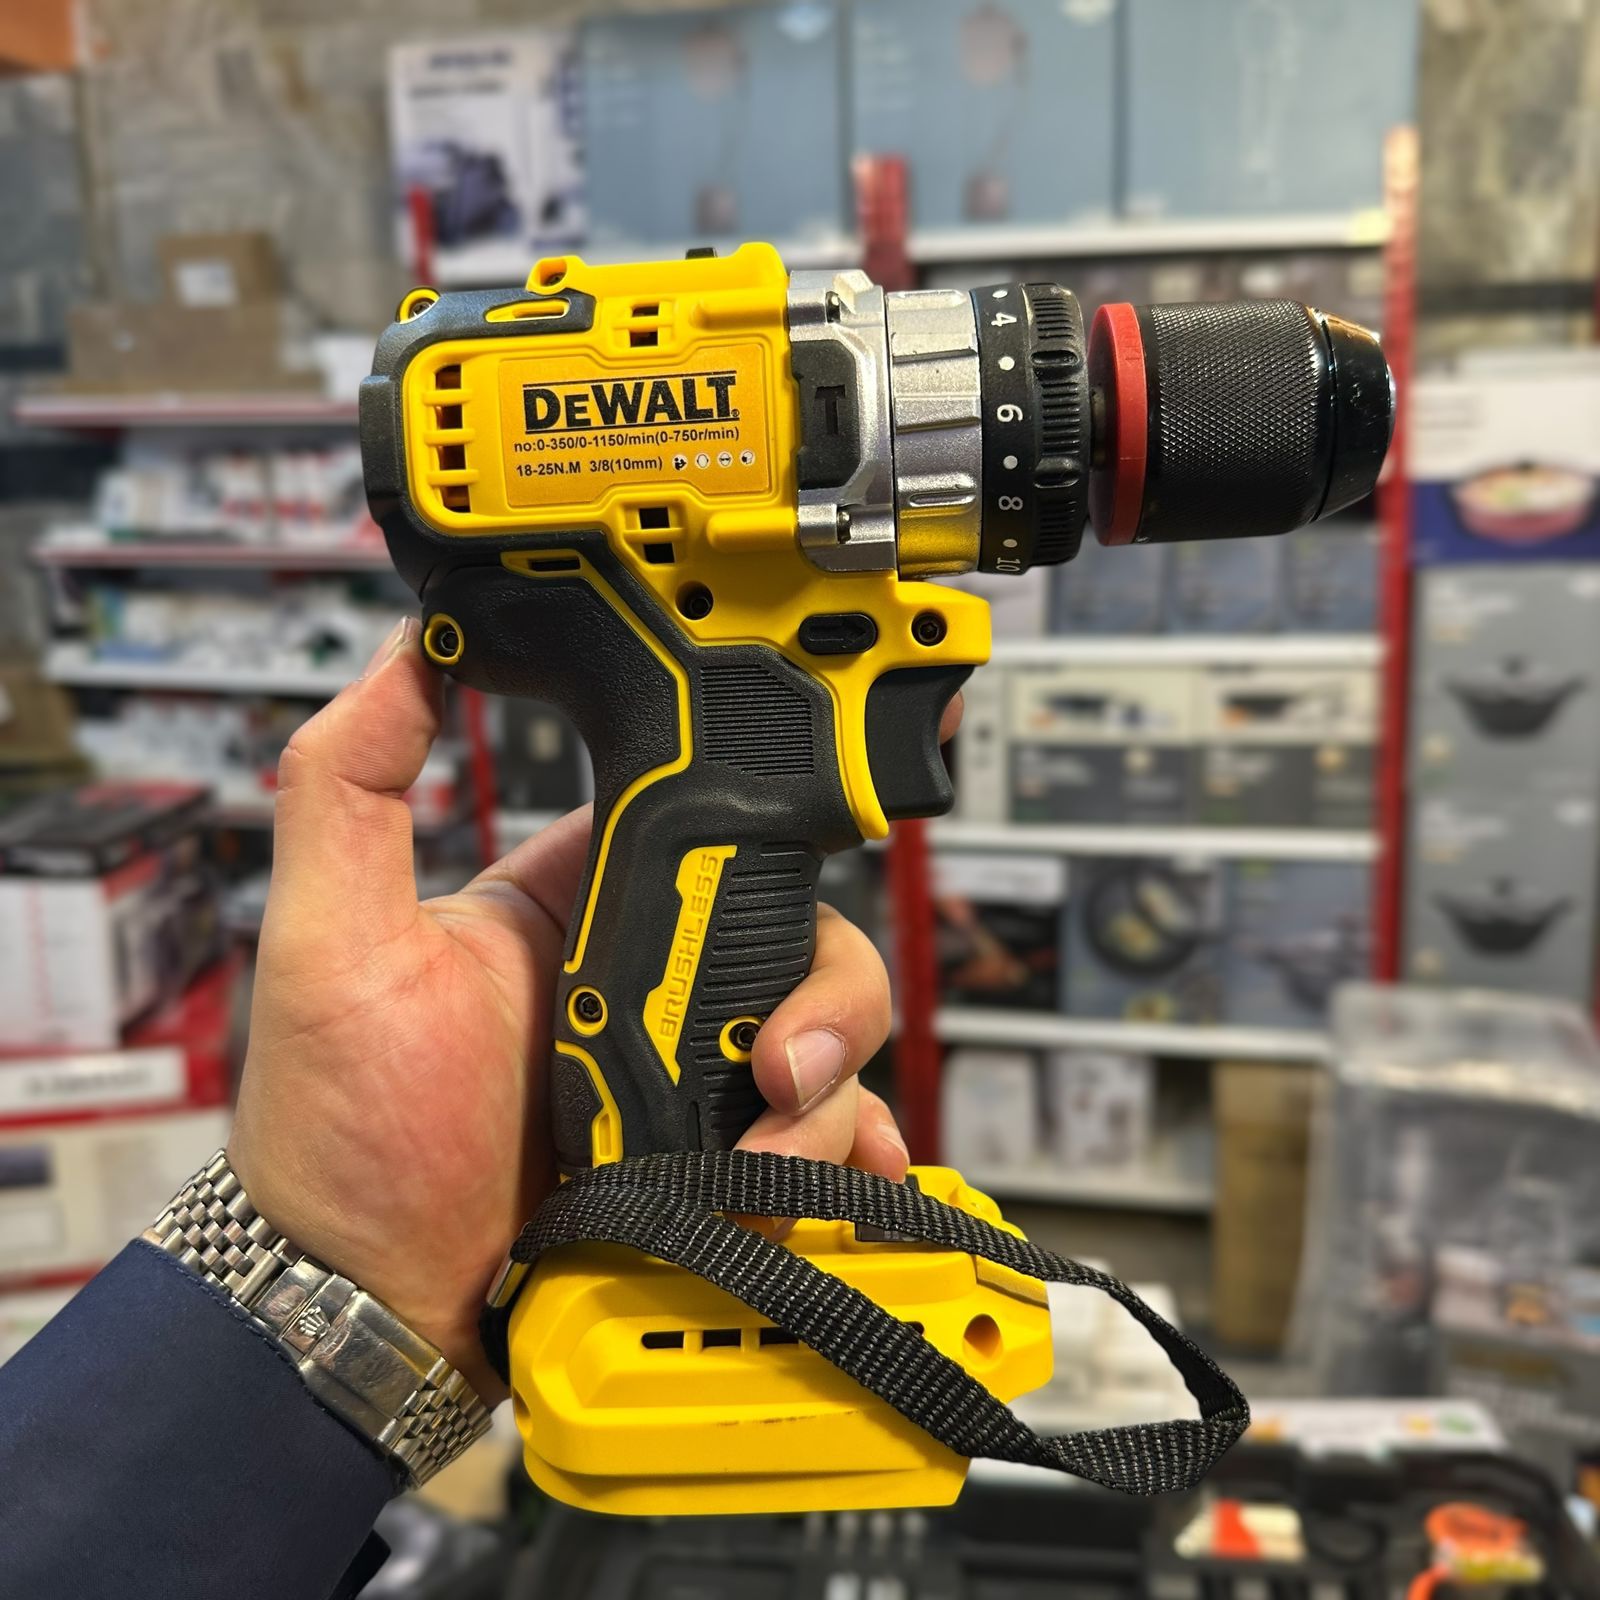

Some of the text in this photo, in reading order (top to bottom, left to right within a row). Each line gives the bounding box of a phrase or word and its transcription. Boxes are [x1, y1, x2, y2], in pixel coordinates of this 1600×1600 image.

[516, 456, 663, 477] 18-25N.M 3/8(10mm)
[990, 312, 1023, 572] 4 6 8 10
[659, 853, 719, 1038] BRUSHLESS
